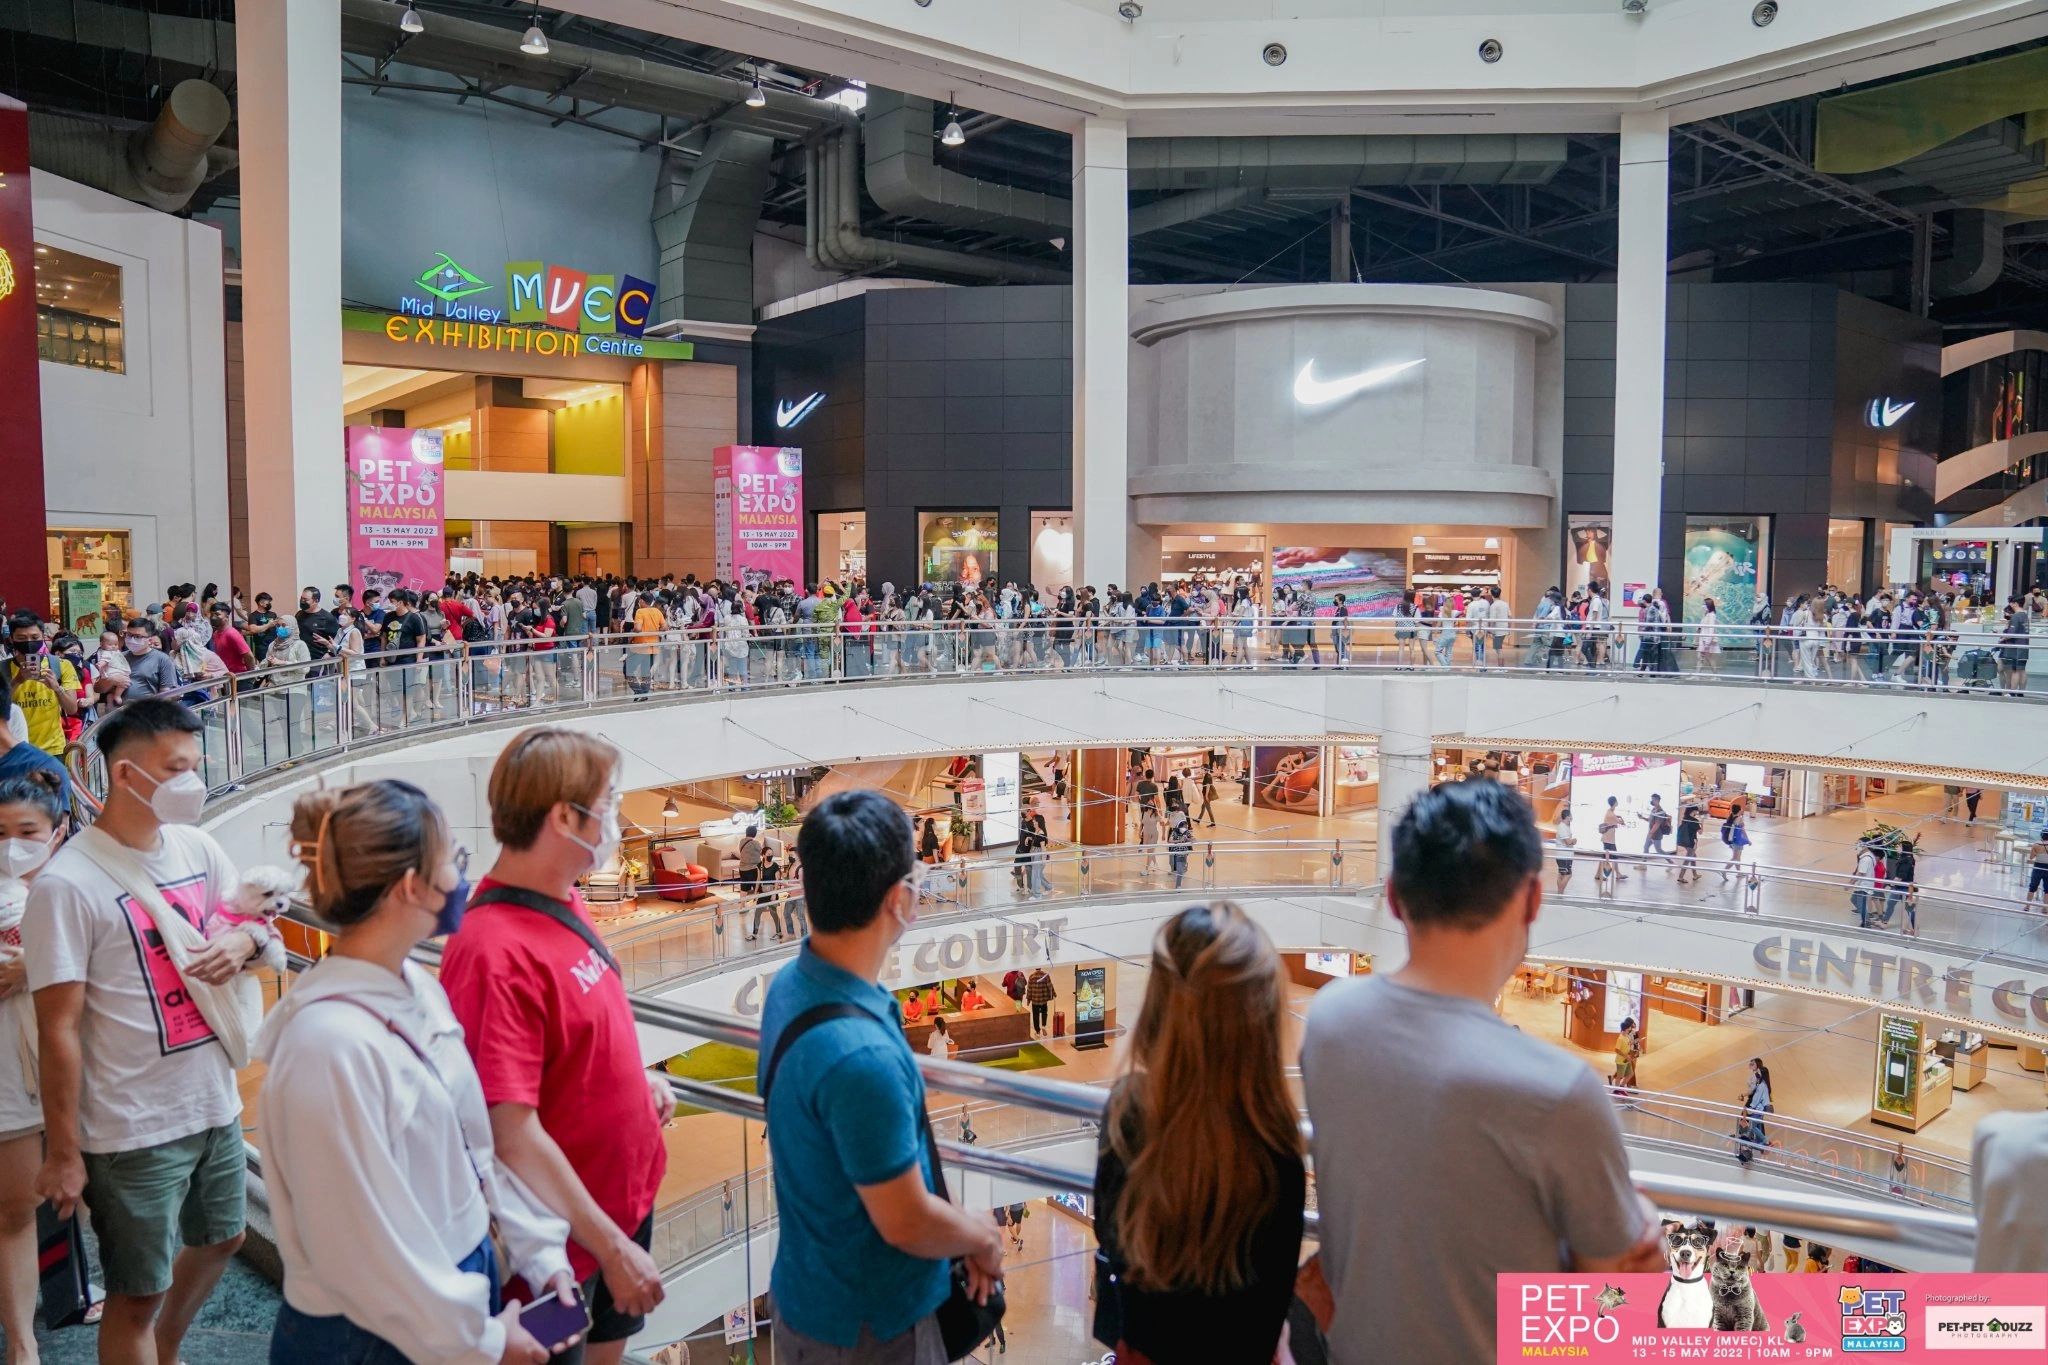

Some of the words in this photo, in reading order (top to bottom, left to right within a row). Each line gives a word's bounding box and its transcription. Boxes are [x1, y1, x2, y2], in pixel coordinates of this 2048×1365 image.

[401, 296, 434, 317] Mid
[446, 299, 502, 325] Valley
[511, 272, 650, 326] MVEC
[385, 315, 580, 357] EXHIBITION
[585, 336, 643, 357] Centre
[359, 458, 413, 482] PET
[359, 482, 436, 506] EXPO
[738, 473, 778, 493] PET
[359, 505, 438, 520] MALAYSIA
[739, 493, 796, 513] EXPO
[364, 526, 373, 534] 13
[382, 526, 391, 534] 15
[414, 527, 434, 535] 2022
[739, 514, 798, 525] MALAYSIA
[913, 917, 1069, 973] COURT
[1753, 935, 1974, 1007] CENTRE
